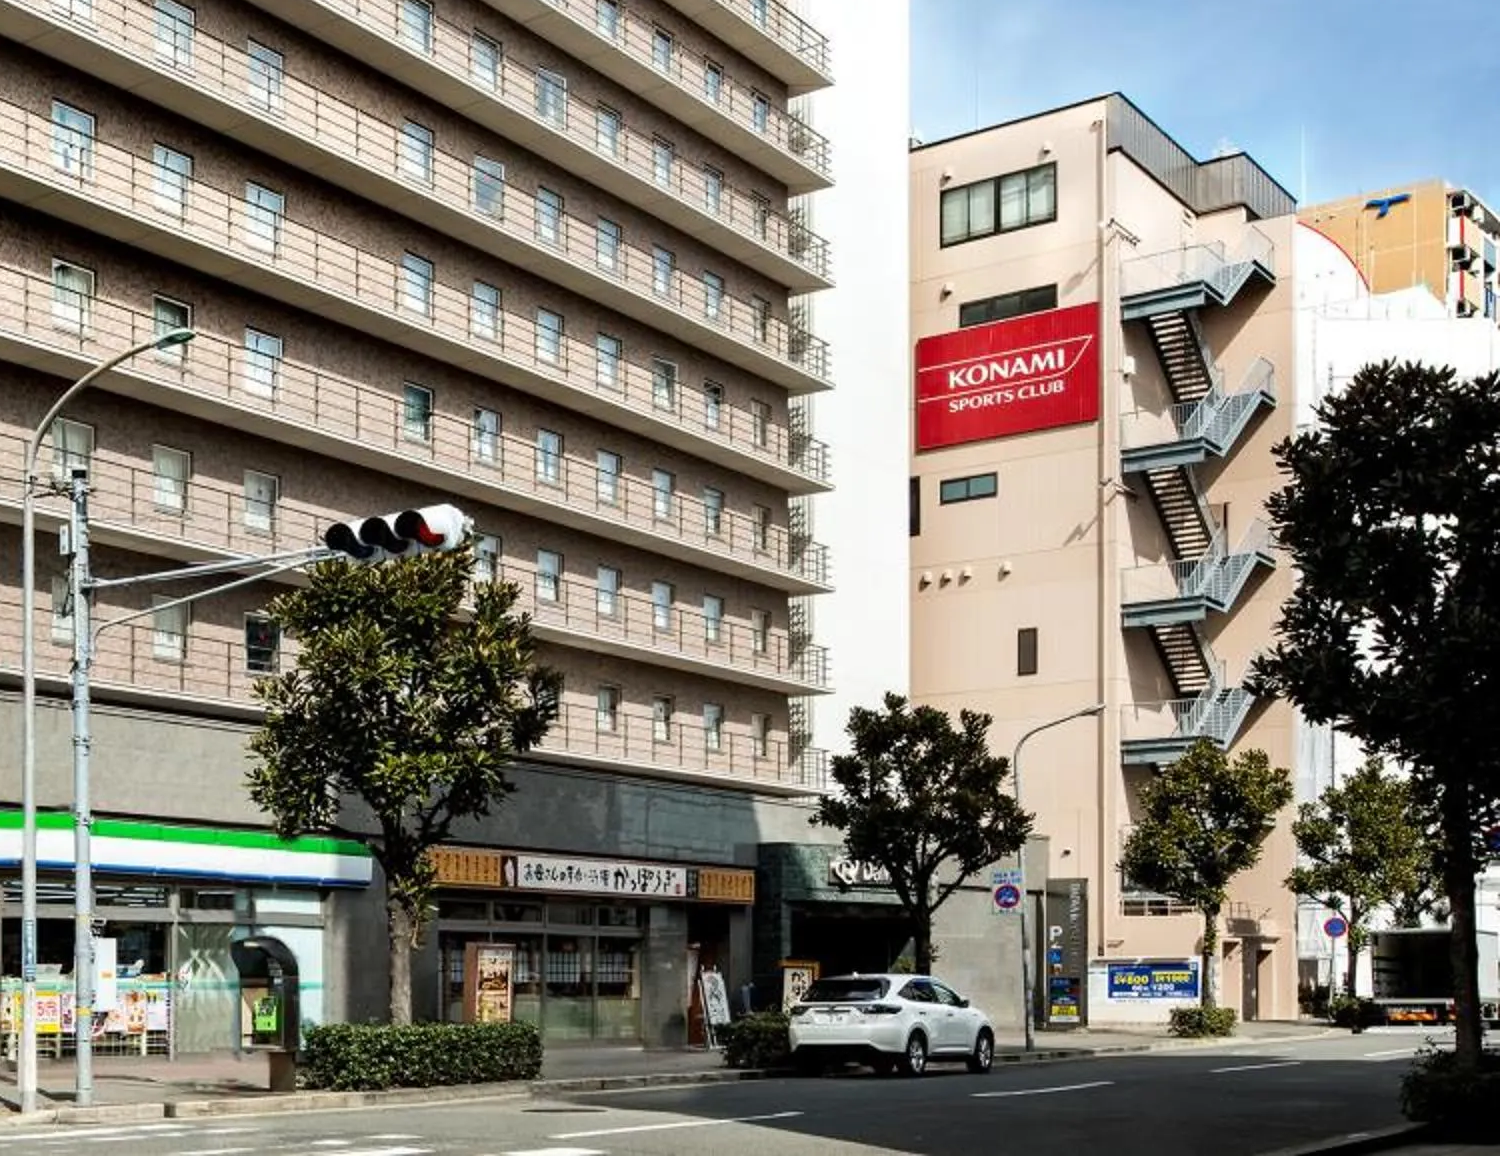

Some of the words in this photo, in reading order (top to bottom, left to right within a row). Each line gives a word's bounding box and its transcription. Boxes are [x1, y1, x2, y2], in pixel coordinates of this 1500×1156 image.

[949, 348, 1065, 389] KONAMI
[949, 389, 1014, 413] SPORTS
[1018, 379, 1065, 399] CLUB
[1050, 925, 1063, 941] P
